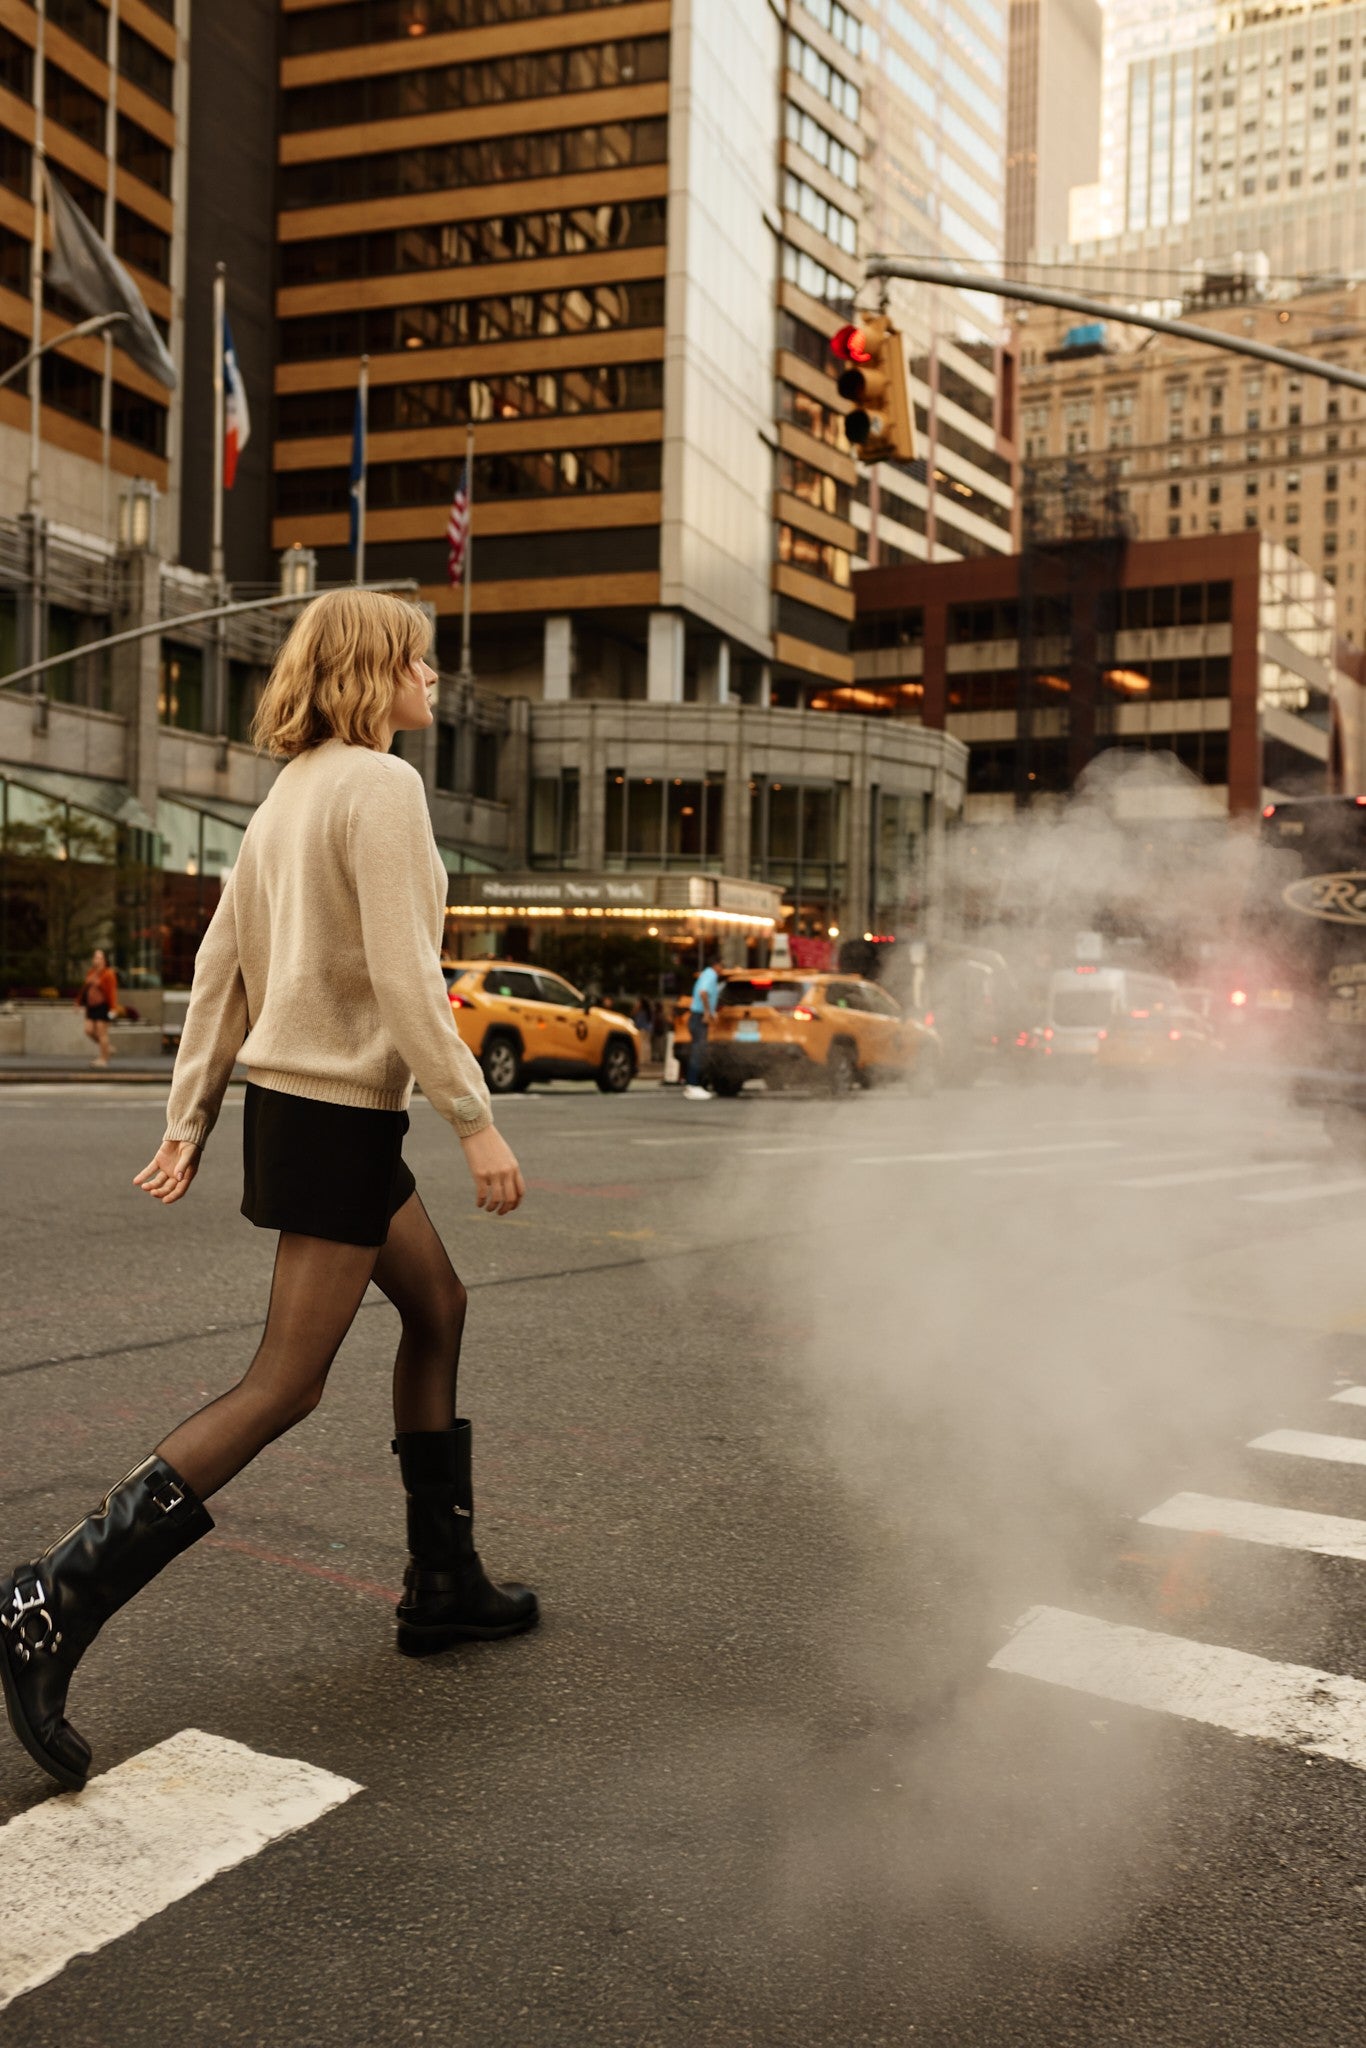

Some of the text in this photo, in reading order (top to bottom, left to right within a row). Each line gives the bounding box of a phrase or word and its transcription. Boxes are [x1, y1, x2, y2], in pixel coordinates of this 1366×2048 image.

[482, 882, 643, 899] Sheraton New York
